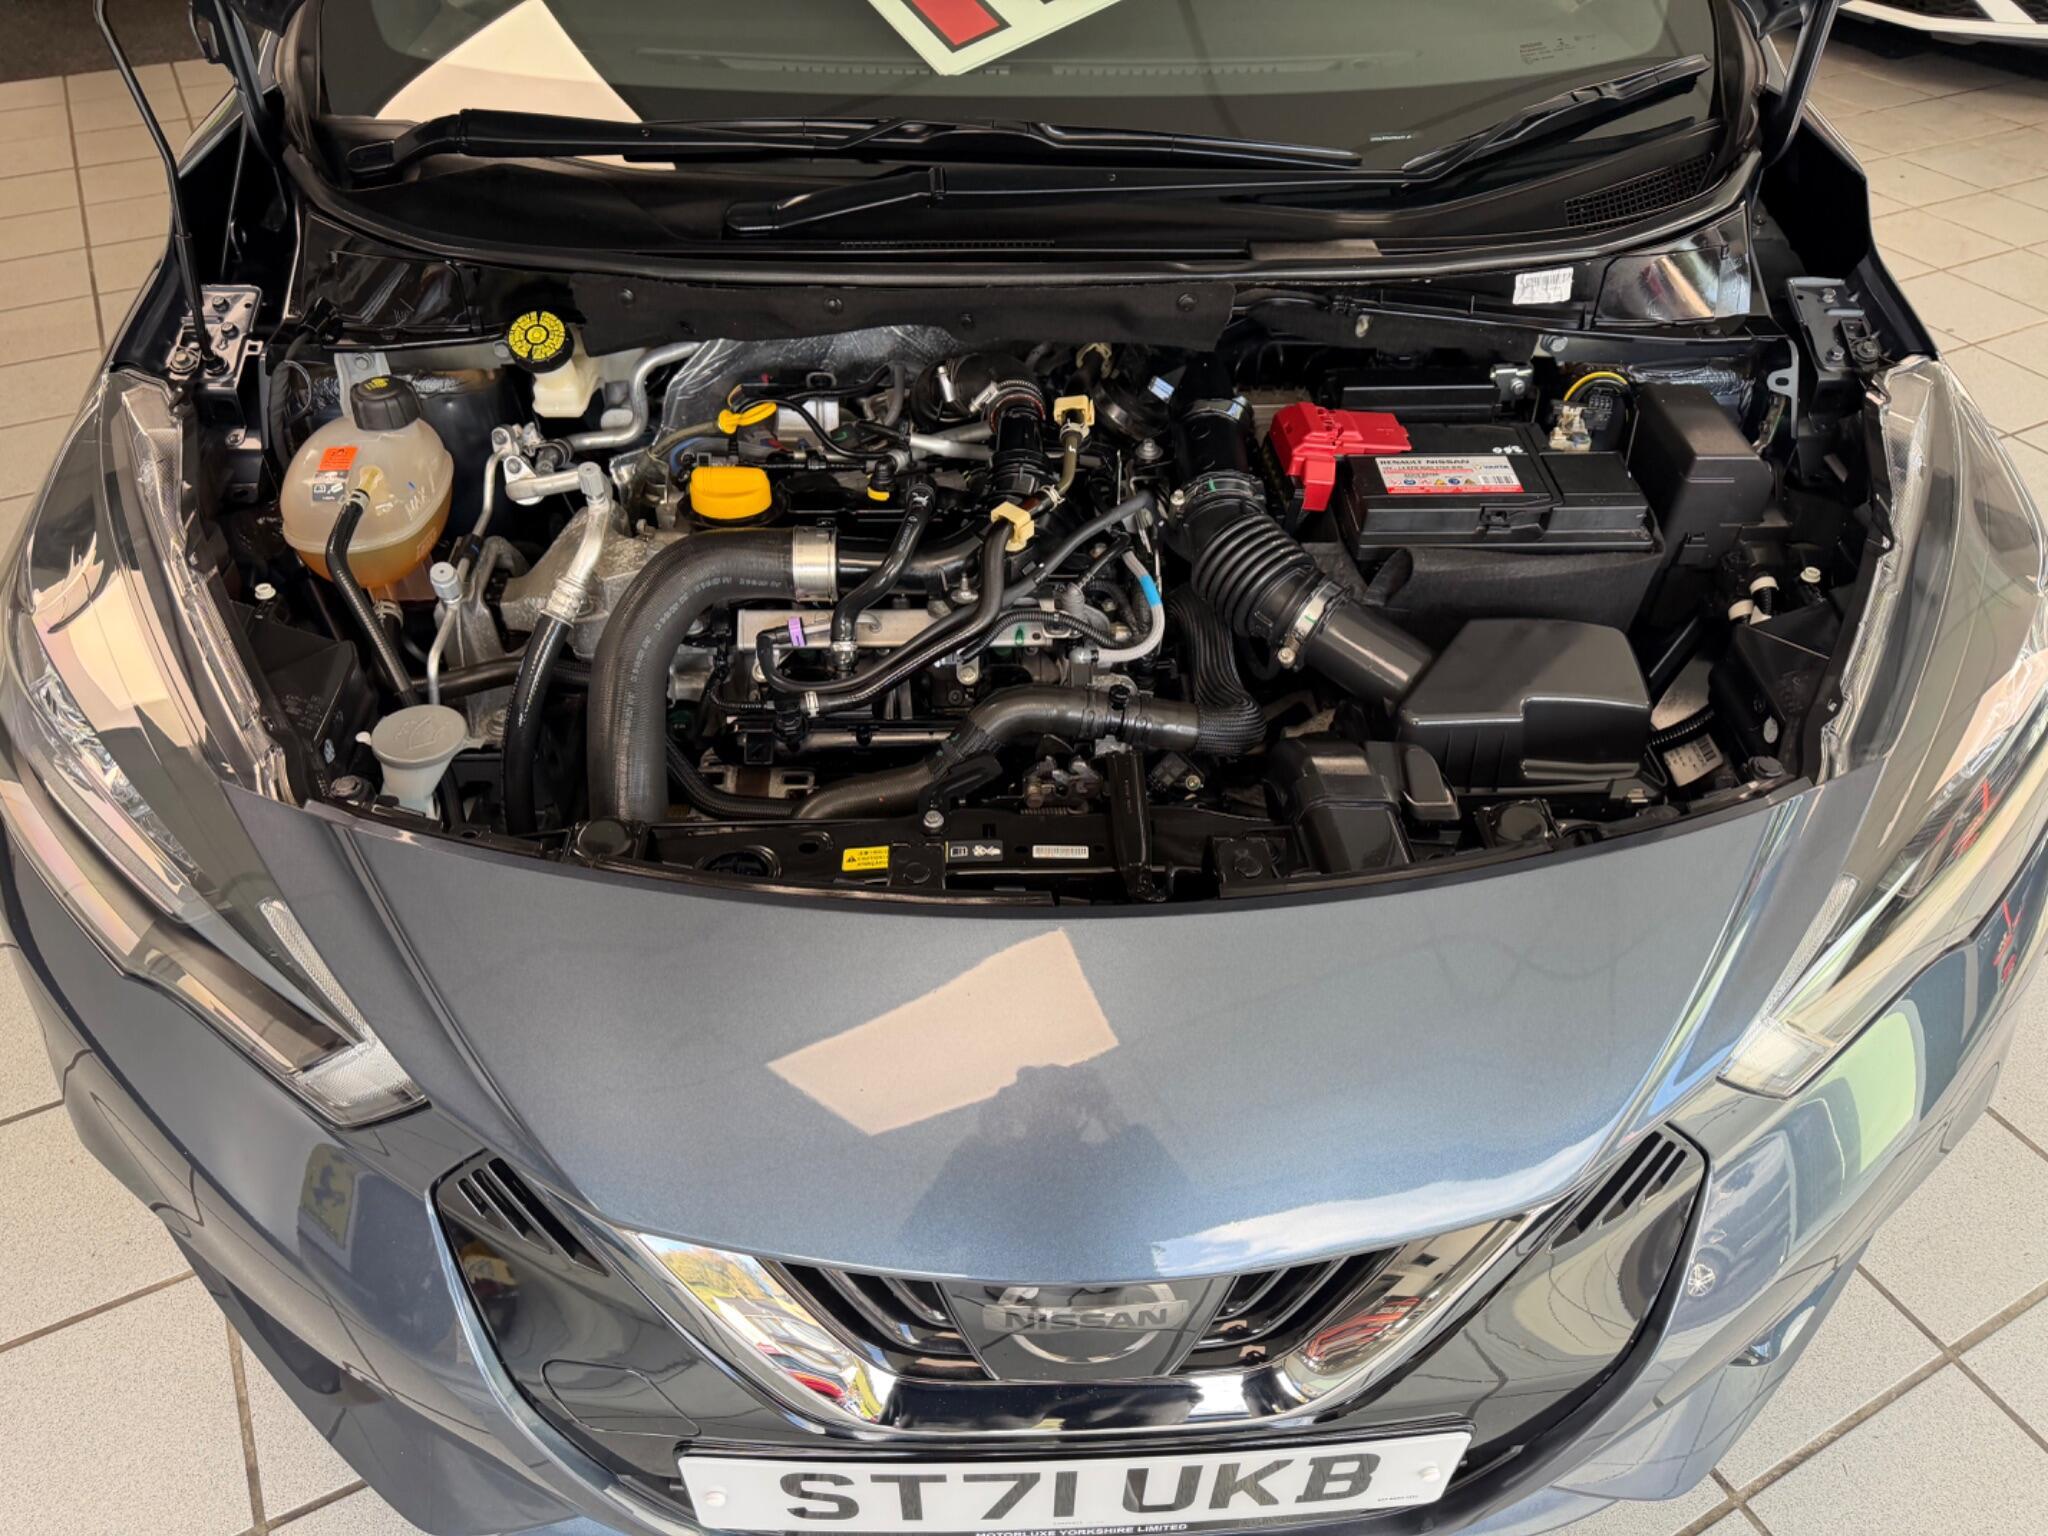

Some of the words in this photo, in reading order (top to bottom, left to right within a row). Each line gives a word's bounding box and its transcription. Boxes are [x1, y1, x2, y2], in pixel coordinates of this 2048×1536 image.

[1005, 1308, 1168, 1330] NISSAN
[779, 1470, 1078, 1522] ST71
[1122, 1452, 1381, 1512] UKB
[1059, 1526, 1135, 1536] YORKSHIRE
[1137, 1523, 1188, 1533] LIMITED
